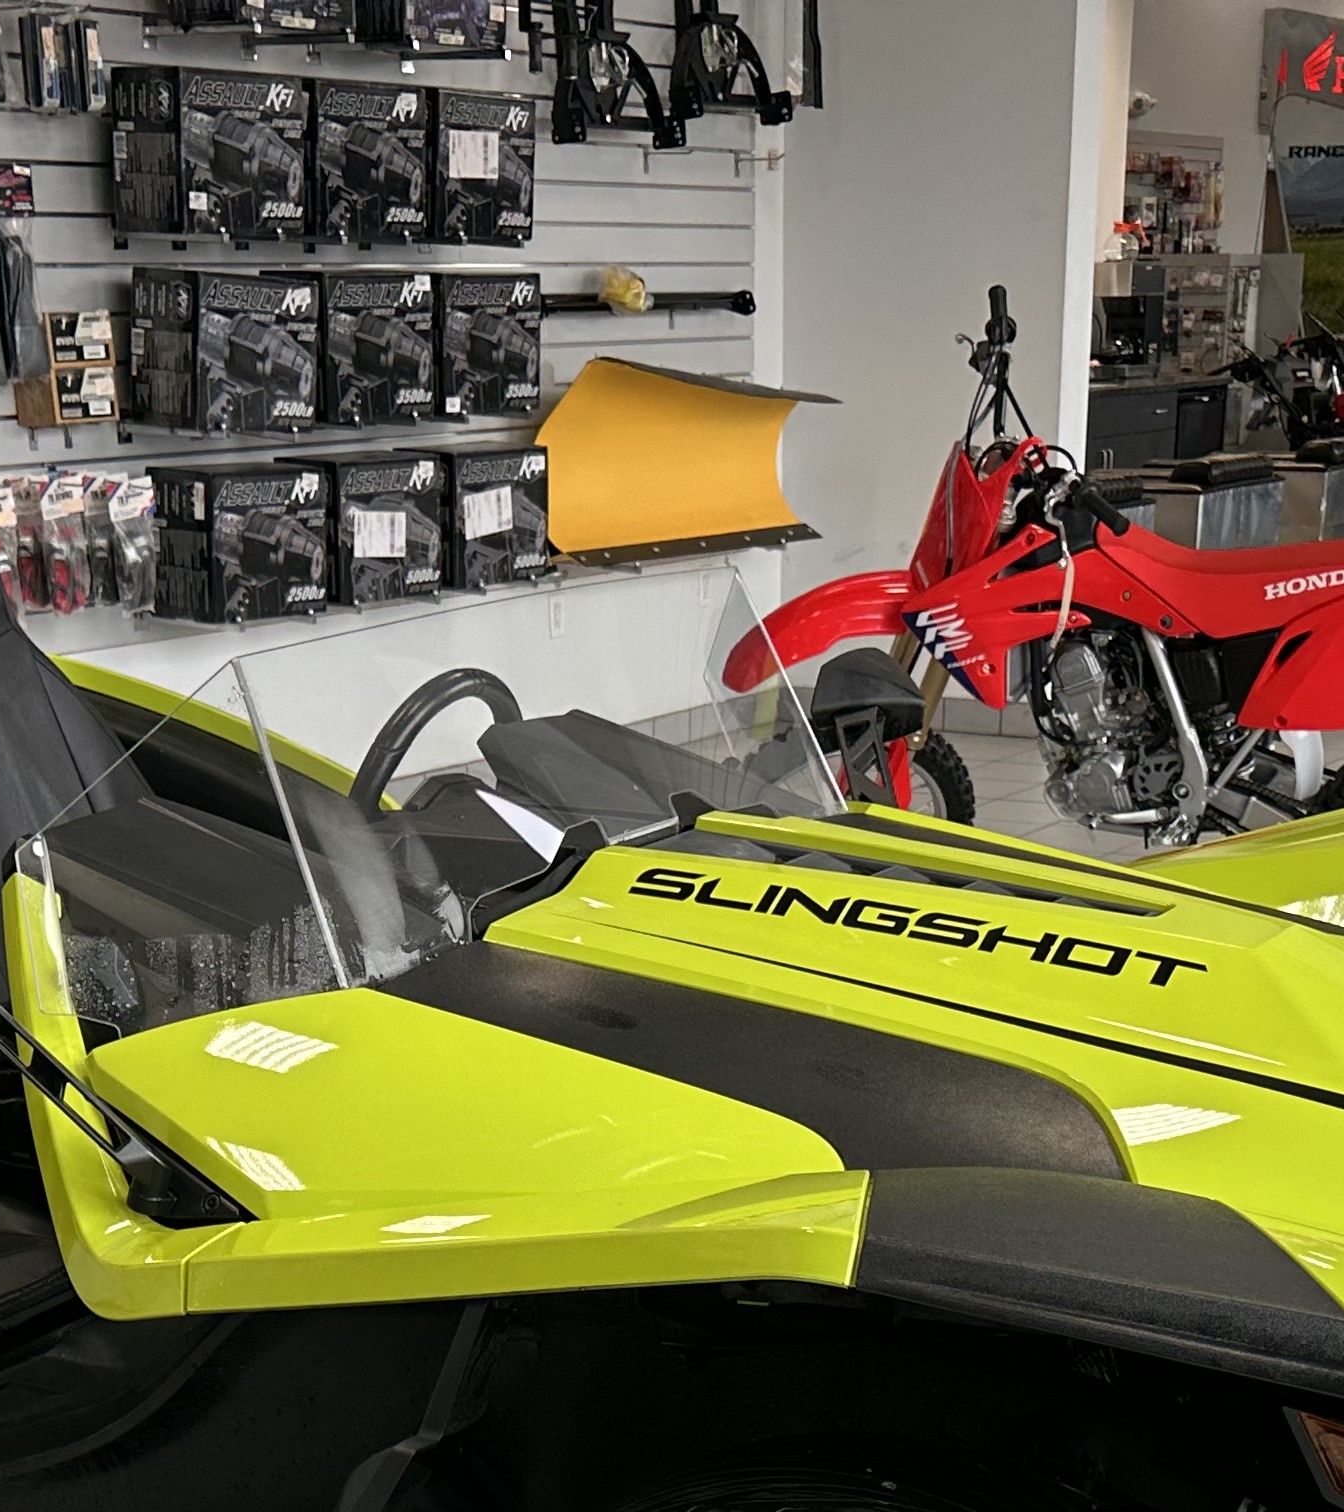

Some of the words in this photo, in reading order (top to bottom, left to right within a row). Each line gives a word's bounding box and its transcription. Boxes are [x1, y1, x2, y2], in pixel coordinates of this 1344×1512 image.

[183, 75, 268, 108] ASSAULT
[319, 88, 394, 118] ASSAULT
[442, 97, 507, 127] ASSAULT
[201, 279, 284, 312] ASSAULT
[328, 280, 401, 307] ASSAULT
[213, 480, 293, 507] ASSAULT
[341, 468, 411, 495] ASSAULT
[627, 868, 1209, 988] SLINGSHOT
